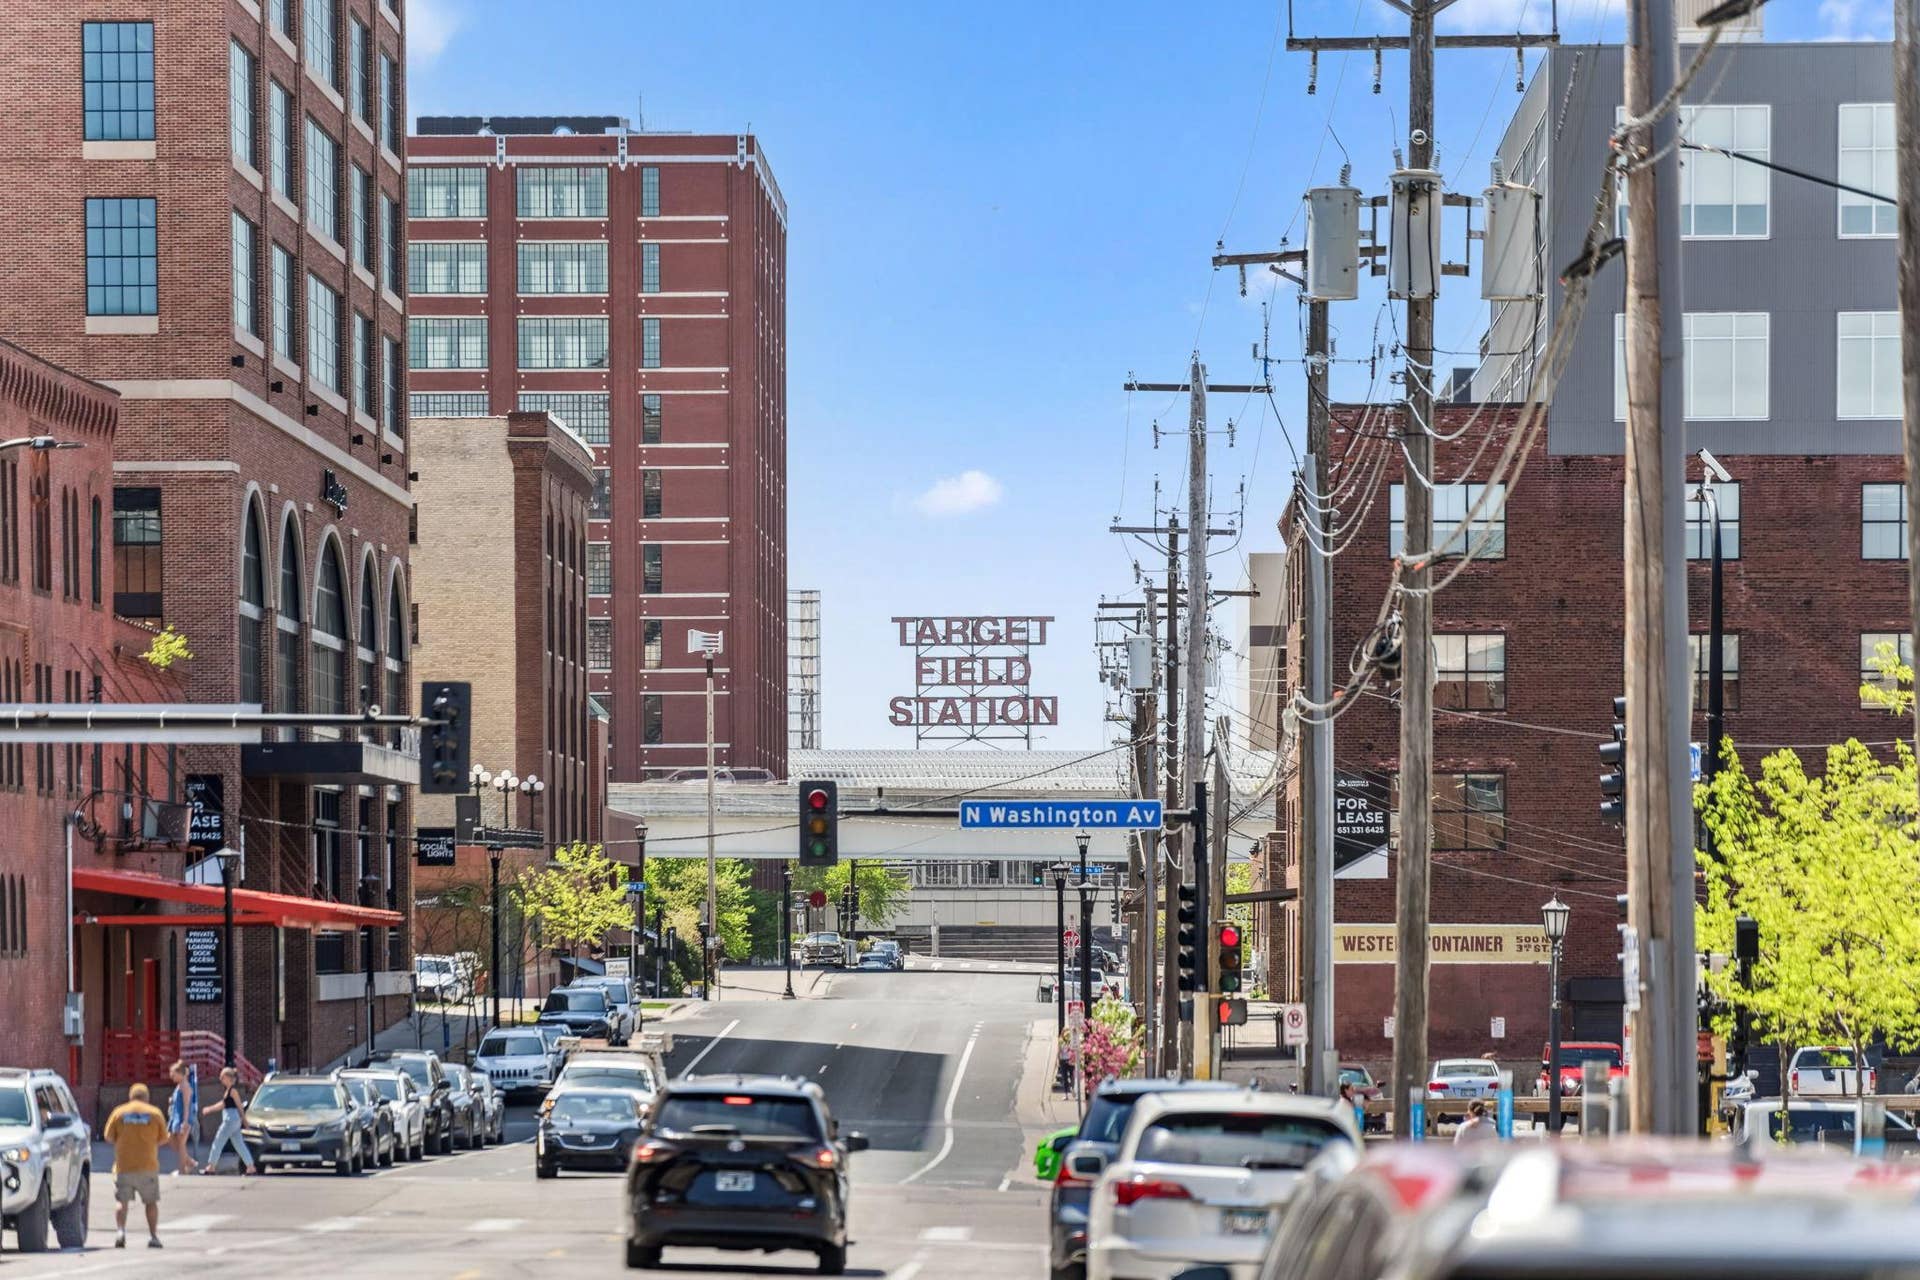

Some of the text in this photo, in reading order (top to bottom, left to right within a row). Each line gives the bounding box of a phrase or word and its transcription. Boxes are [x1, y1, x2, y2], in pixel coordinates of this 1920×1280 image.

[891, 616, 1055, 646] TARGET
[916, 656, 1032, 686] FIELD
[888, 696, 1058, 726] STATION
[1337, 798, 1367, 810] FOR
[191, 815, 220, 828] ASE
[966, 806, 1155, 828] N Washington Av
[1337, 812, 1384, 823] LEASE
[1337, 826, 1384, 834] 651 331 6425
[1342, 935, 1503, 953] WESTE ONTAINER
[1516, 935, 1539, 943] 500
